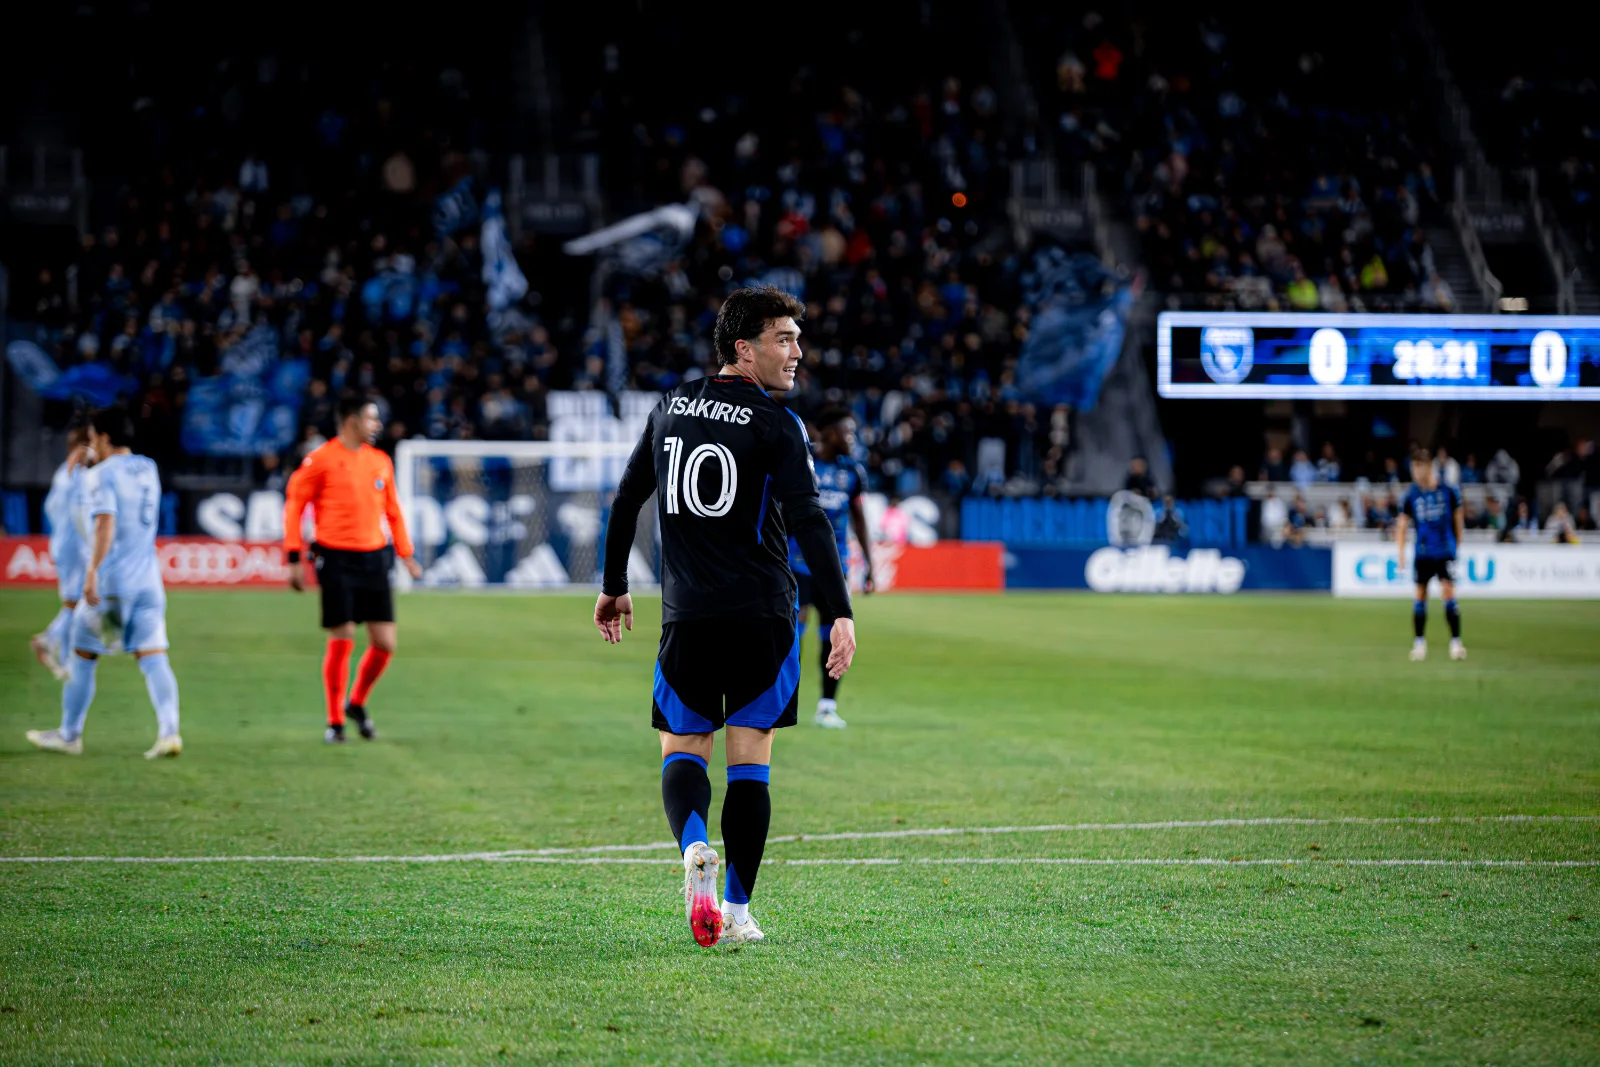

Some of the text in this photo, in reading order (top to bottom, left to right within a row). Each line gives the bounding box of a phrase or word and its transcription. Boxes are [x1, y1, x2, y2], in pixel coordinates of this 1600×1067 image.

[1309, 328, 1348, 385] 0
[1529, 330, 1567, 388] 0
[667, 396, 753, 425] TSAKIRIS
[663, 436, 738, 518] 10
[1085, 545, 1246, 593] Gillette
